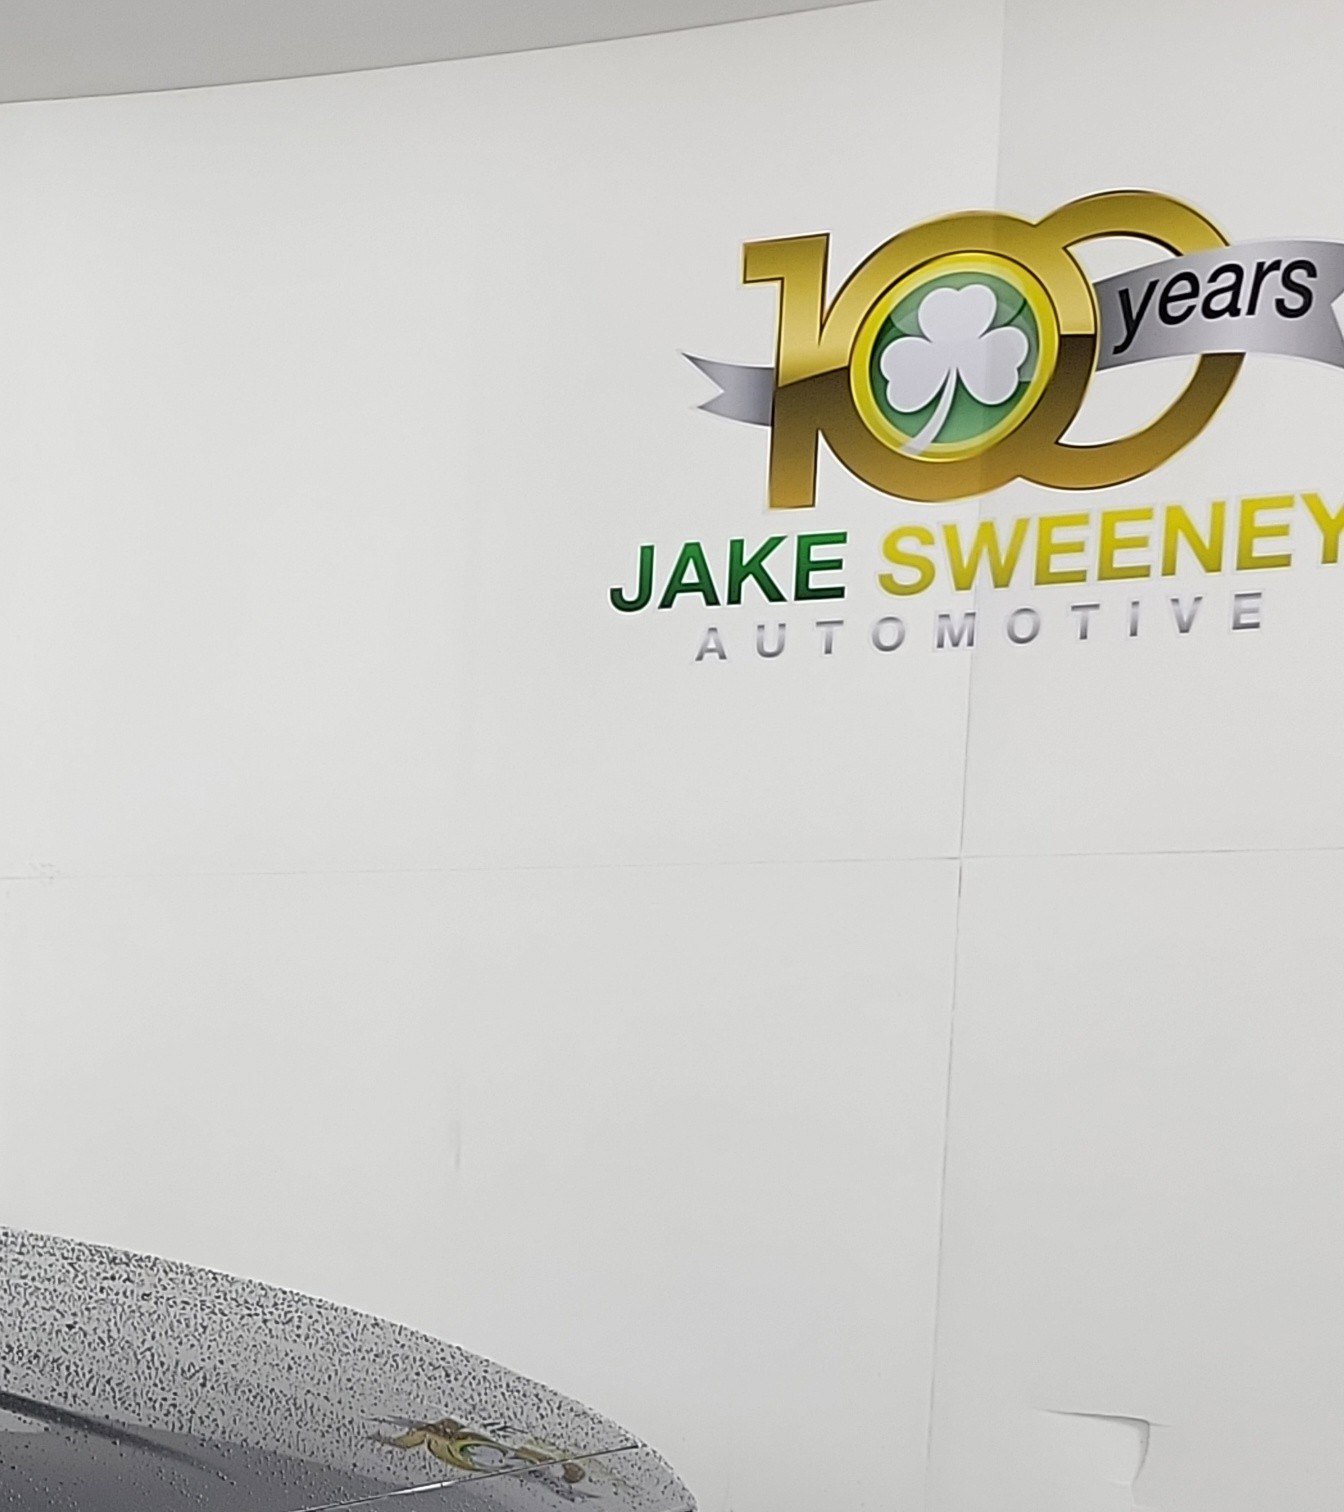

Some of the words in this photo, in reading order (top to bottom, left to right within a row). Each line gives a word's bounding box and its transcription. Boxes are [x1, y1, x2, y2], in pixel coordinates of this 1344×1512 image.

[1113, 259, 1318, 355] years
[611, 531, 848, 613] JAKE
[877, 491, 1344, 597] SWEENEY
[694, 592, 1263, 662] AUTOMOTIVE
